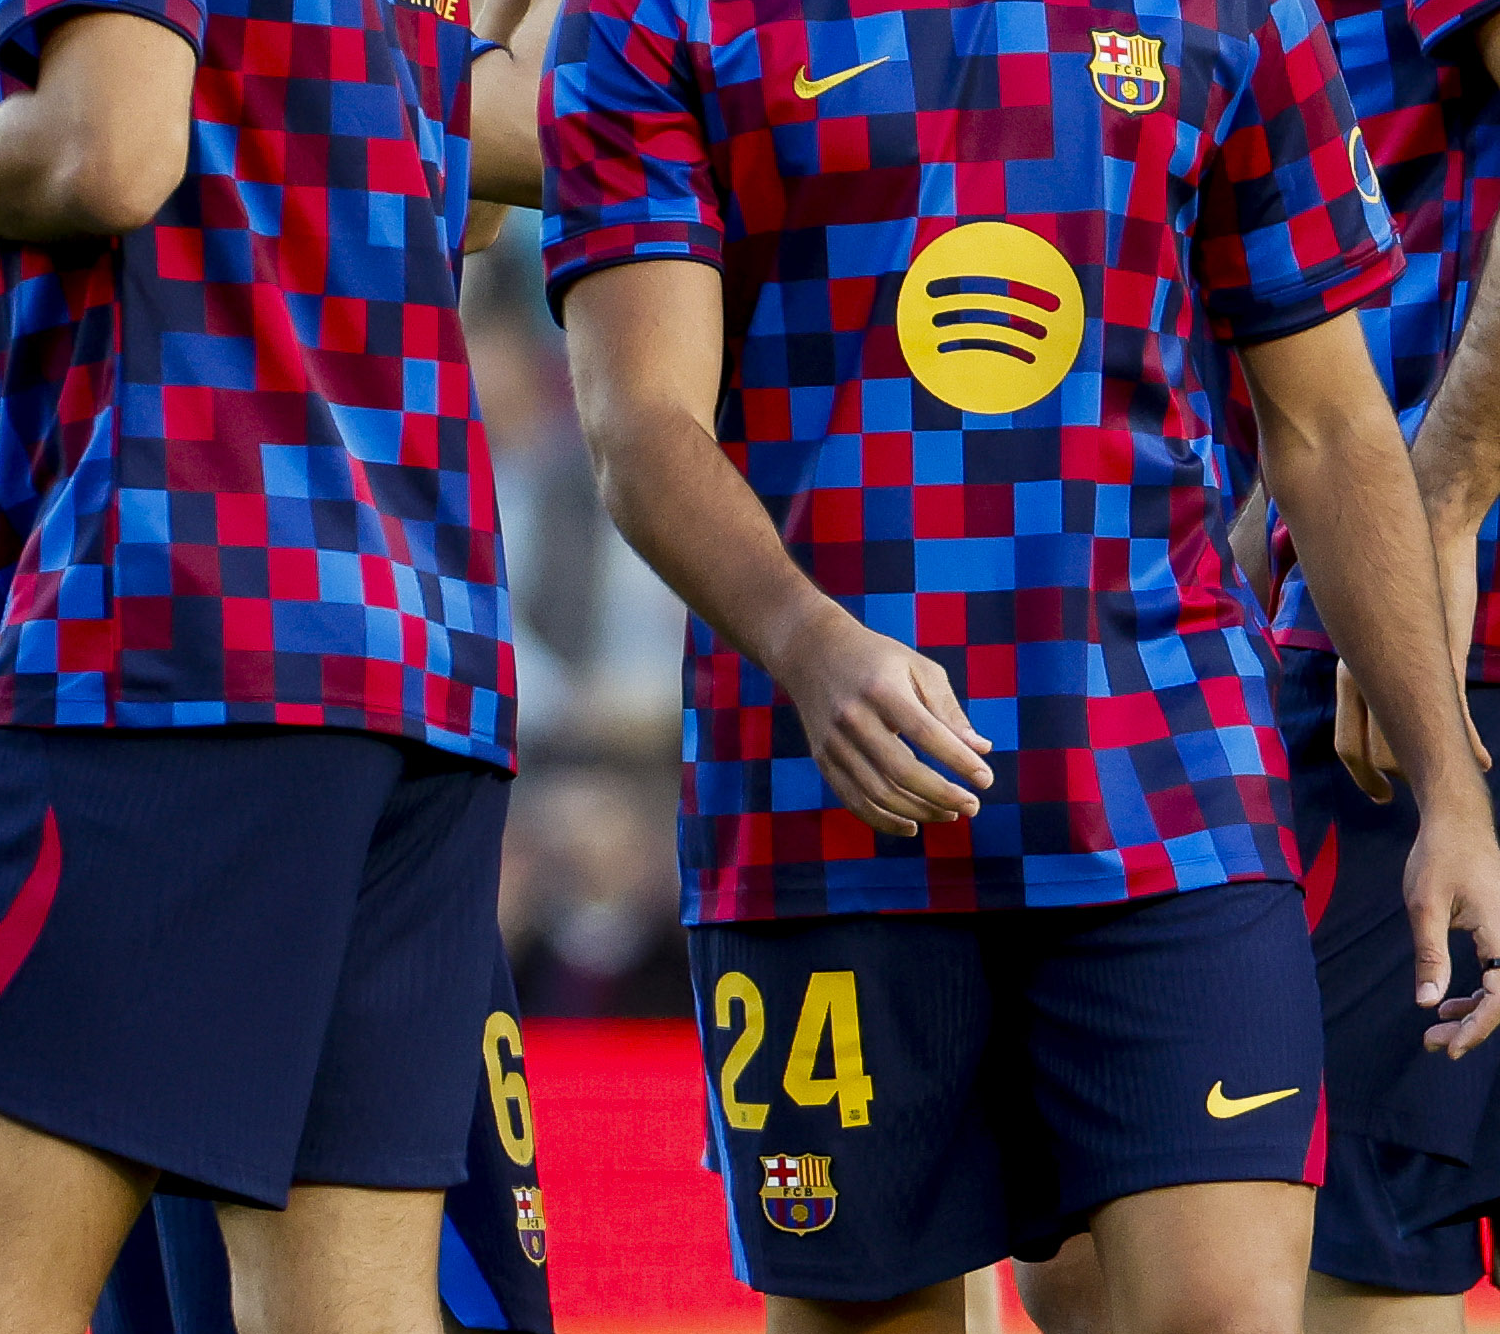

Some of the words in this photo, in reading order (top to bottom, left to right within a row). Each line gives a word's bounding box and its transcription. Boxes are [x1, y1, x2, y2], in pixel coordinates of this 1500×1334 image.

[1114, 64, 1143, 76] FCB
[483, 1011, 535, 1166] 6
[715, 970, 874, 1130] 24
[782, 1187, 814, 1198] FCB
